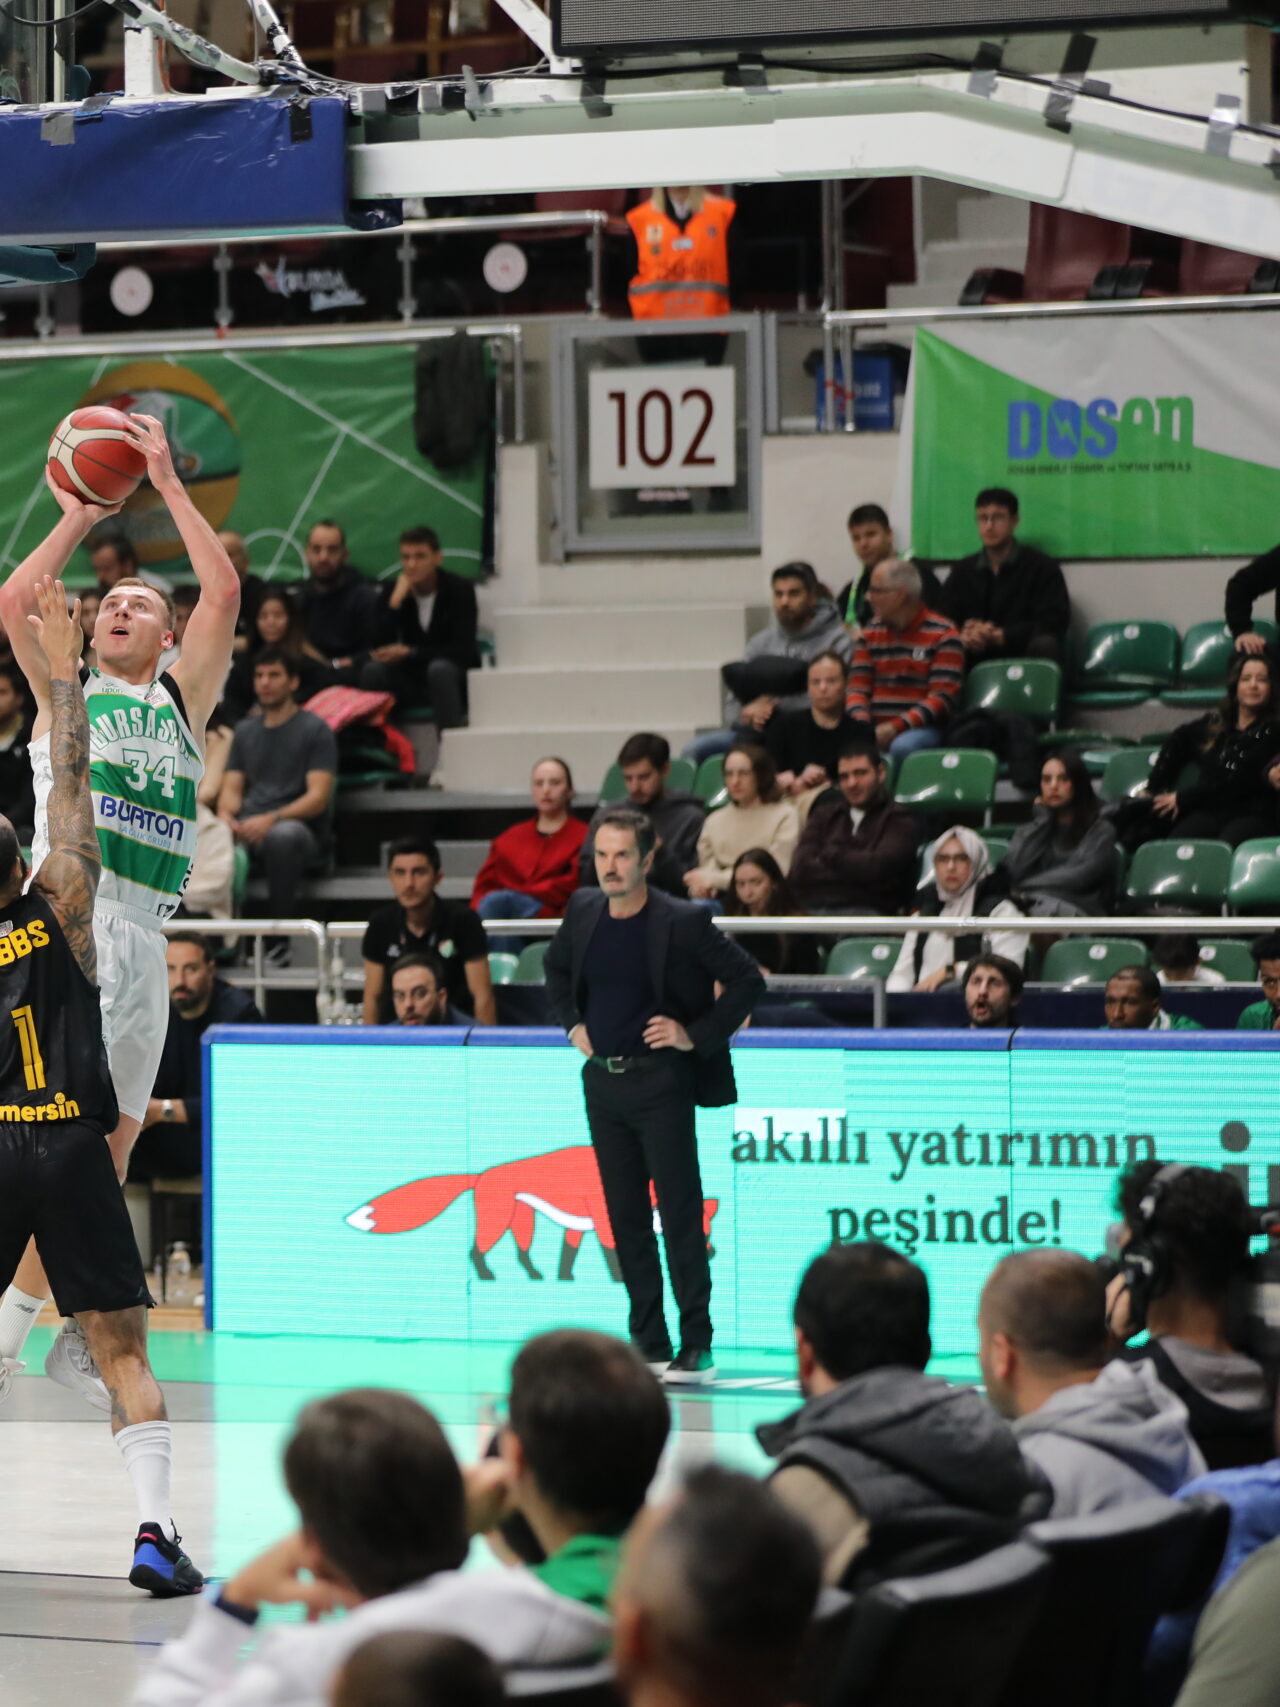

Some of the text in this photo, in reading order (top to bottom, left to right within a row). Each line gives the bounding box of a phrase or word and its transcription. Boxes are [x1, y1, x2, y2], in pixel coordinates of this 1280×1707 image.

[607, 388, 716, 469] 102
[123, 748, 176, 799] 34
[100, 796, 184, 841] BURTON
[10, 1004, 47, 1091] 1
[731, 1115, 870, 1164] akıllı
[887, 1122, 1158, 1181] yatırımın
[826, 1193, 1062, 1255] peşinde!
